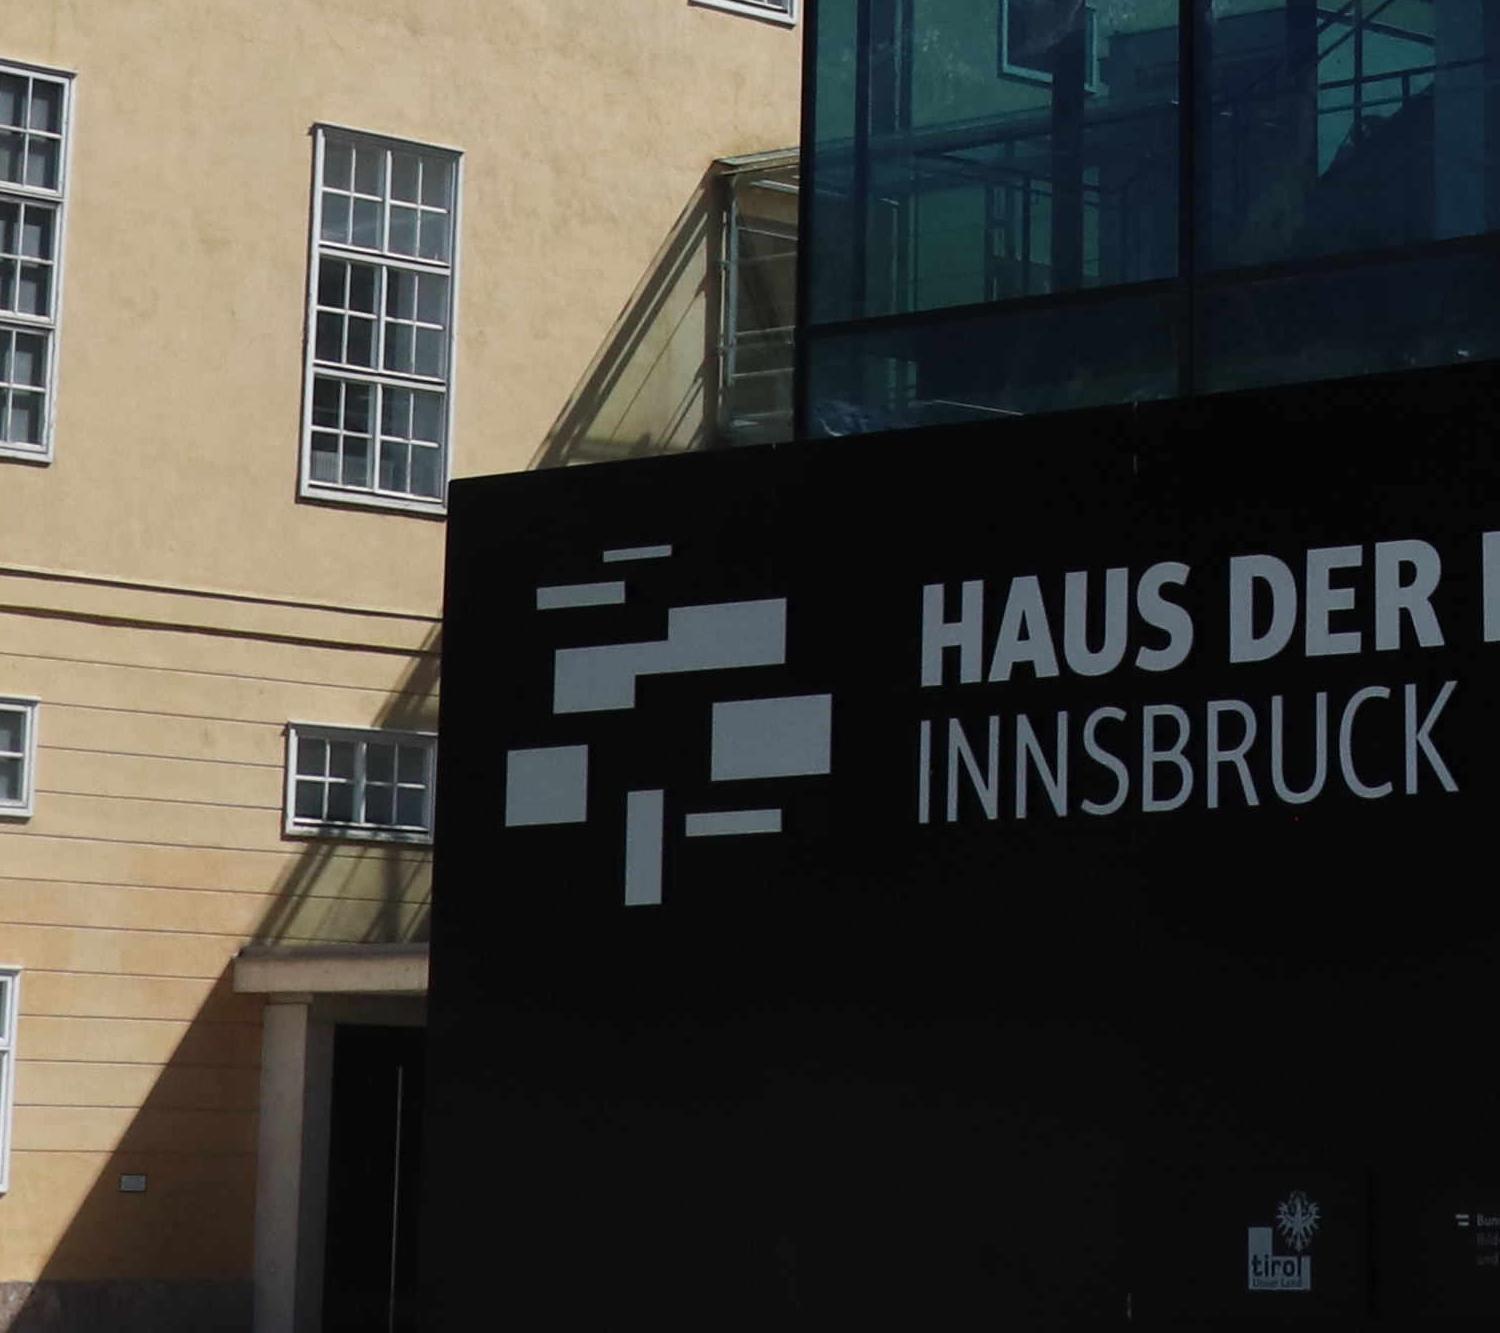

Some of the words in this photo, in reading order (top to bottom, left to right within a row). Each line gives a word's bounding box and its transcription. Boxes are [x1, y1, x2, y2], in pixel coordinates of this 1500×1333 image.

[921, 561, 1194, 687] HAUS
[1229, 539, 1445, 664] DER
[918, 680, 1459, 824] INNSBRUCK
[1252, 1254, 1301, 1277] tirol
[1477, 1253, 1498, 1265] und
